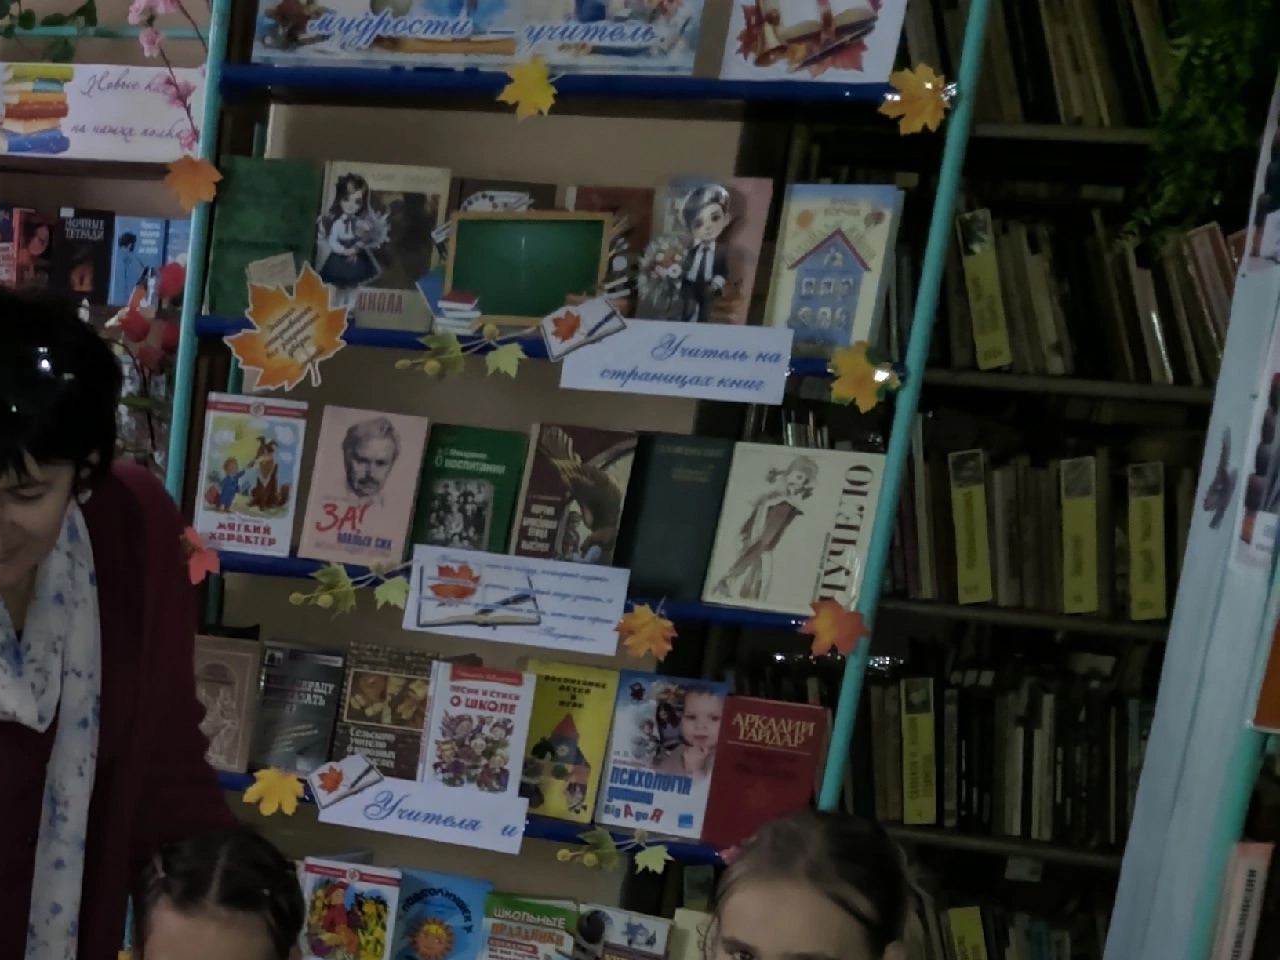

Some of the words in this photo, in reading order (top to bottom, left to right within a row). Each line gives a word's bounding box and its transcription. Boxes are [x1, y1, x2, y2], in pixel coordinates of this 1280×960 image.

[308, 9, 471, 49] мудрости
[141, 118, 185, 138] полка
[650, 333, 753, 364] Учитель
[756, 350, 782, 364] на
[600, 365, 713, 389] страницах
[719, 376, 764, 391] книг
[450, 695, 462, 707] О
[464, 697, 517, 715] ШКОЛЕ
[364, 790, 481, 831] Учителя
[493, 907, 566, 929] ШКОЛЬНЫЕ
